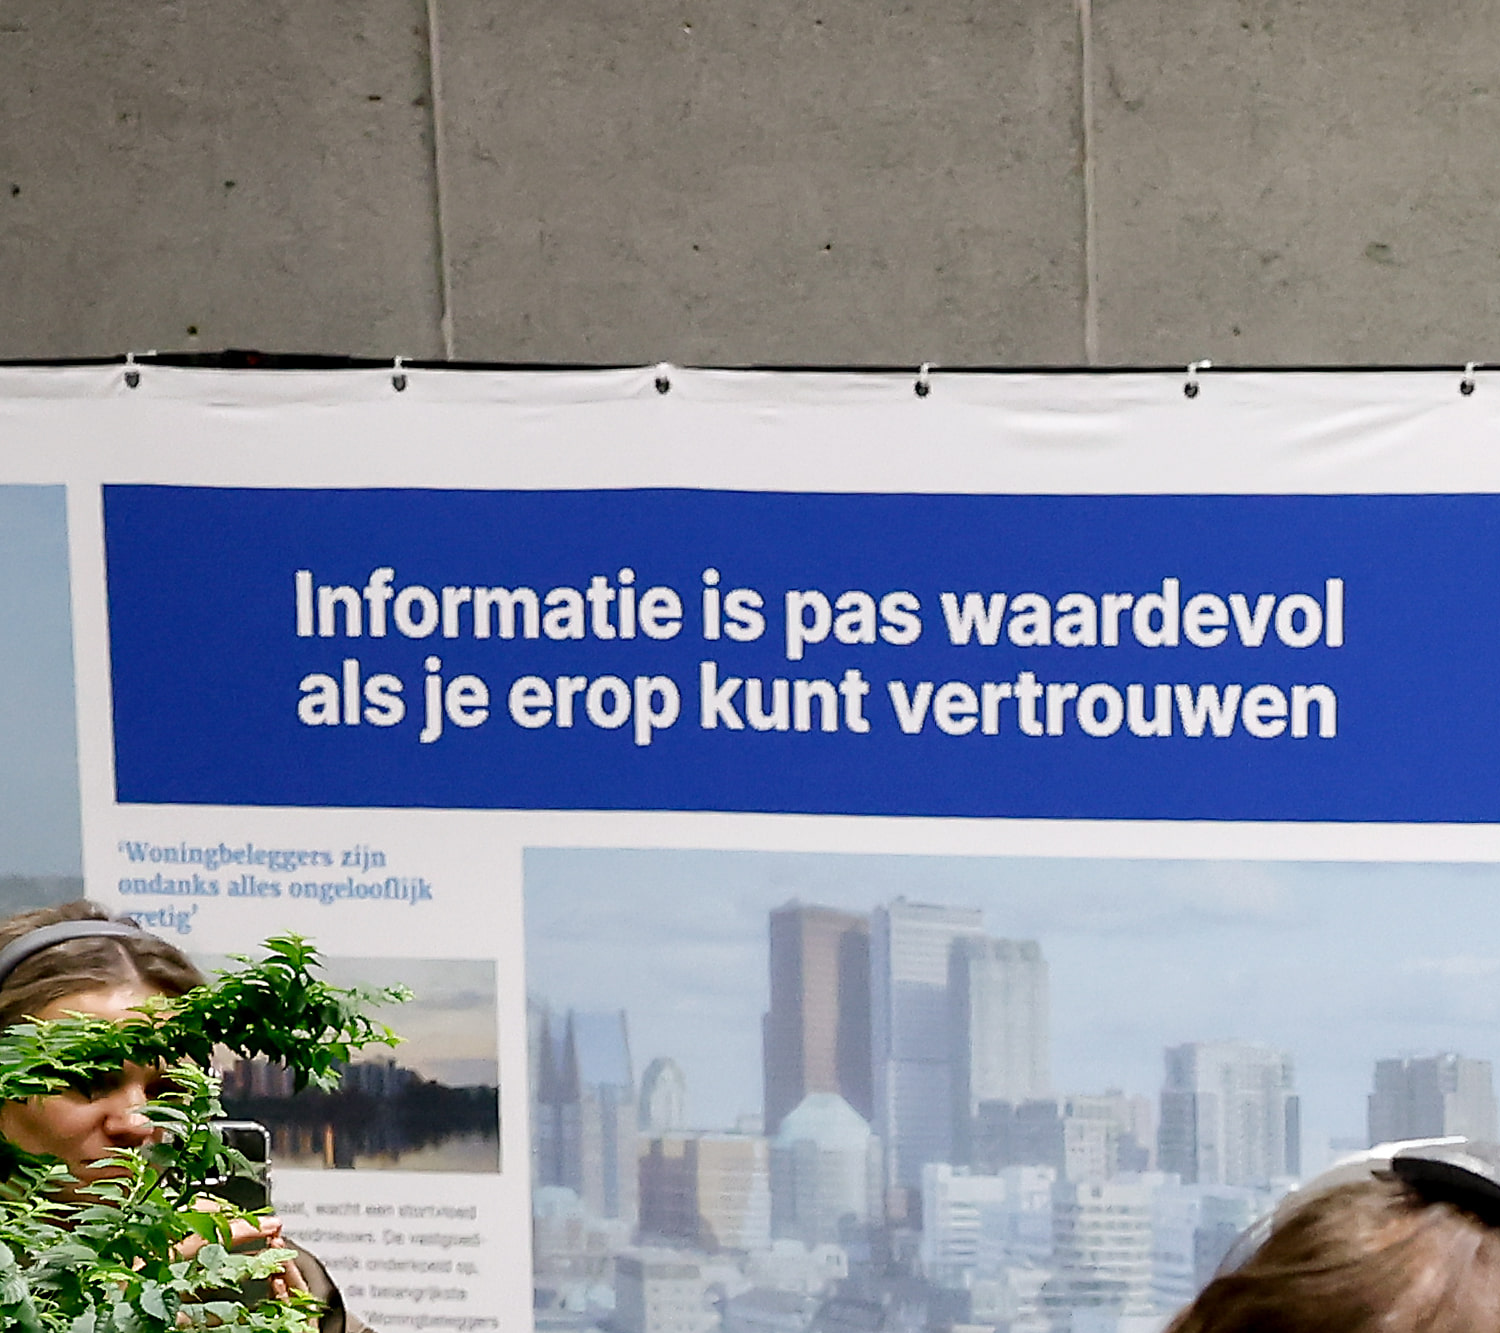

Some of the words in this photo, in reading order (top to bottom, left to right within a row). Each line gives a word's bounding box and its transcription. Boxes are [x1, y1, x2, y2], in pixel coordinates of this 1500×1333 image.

[295, 567, 683, 640] Informatie
[702, 567, 765, 642] is
[785, 590, 922, 661] pas
[940, 577, 1344, 648] waardevol
[298, 658, 405, 726] als
[419, 656, 489, 744] je
[508, 676, 680, 746] erop
[700, 661, 870, 733] kunt
[887, 671, 1337, 739] vertrouwen
[118, 841, 333, 872] ‘Woningbeleggers
[341, 845, 387, 873] zijn
[118, 872, 220, 897] ondanks
[227, 874, 282, 898] alles
[288, 876, 433, 905] ongelooflijk
[126, 904, 198, 934] retig’
